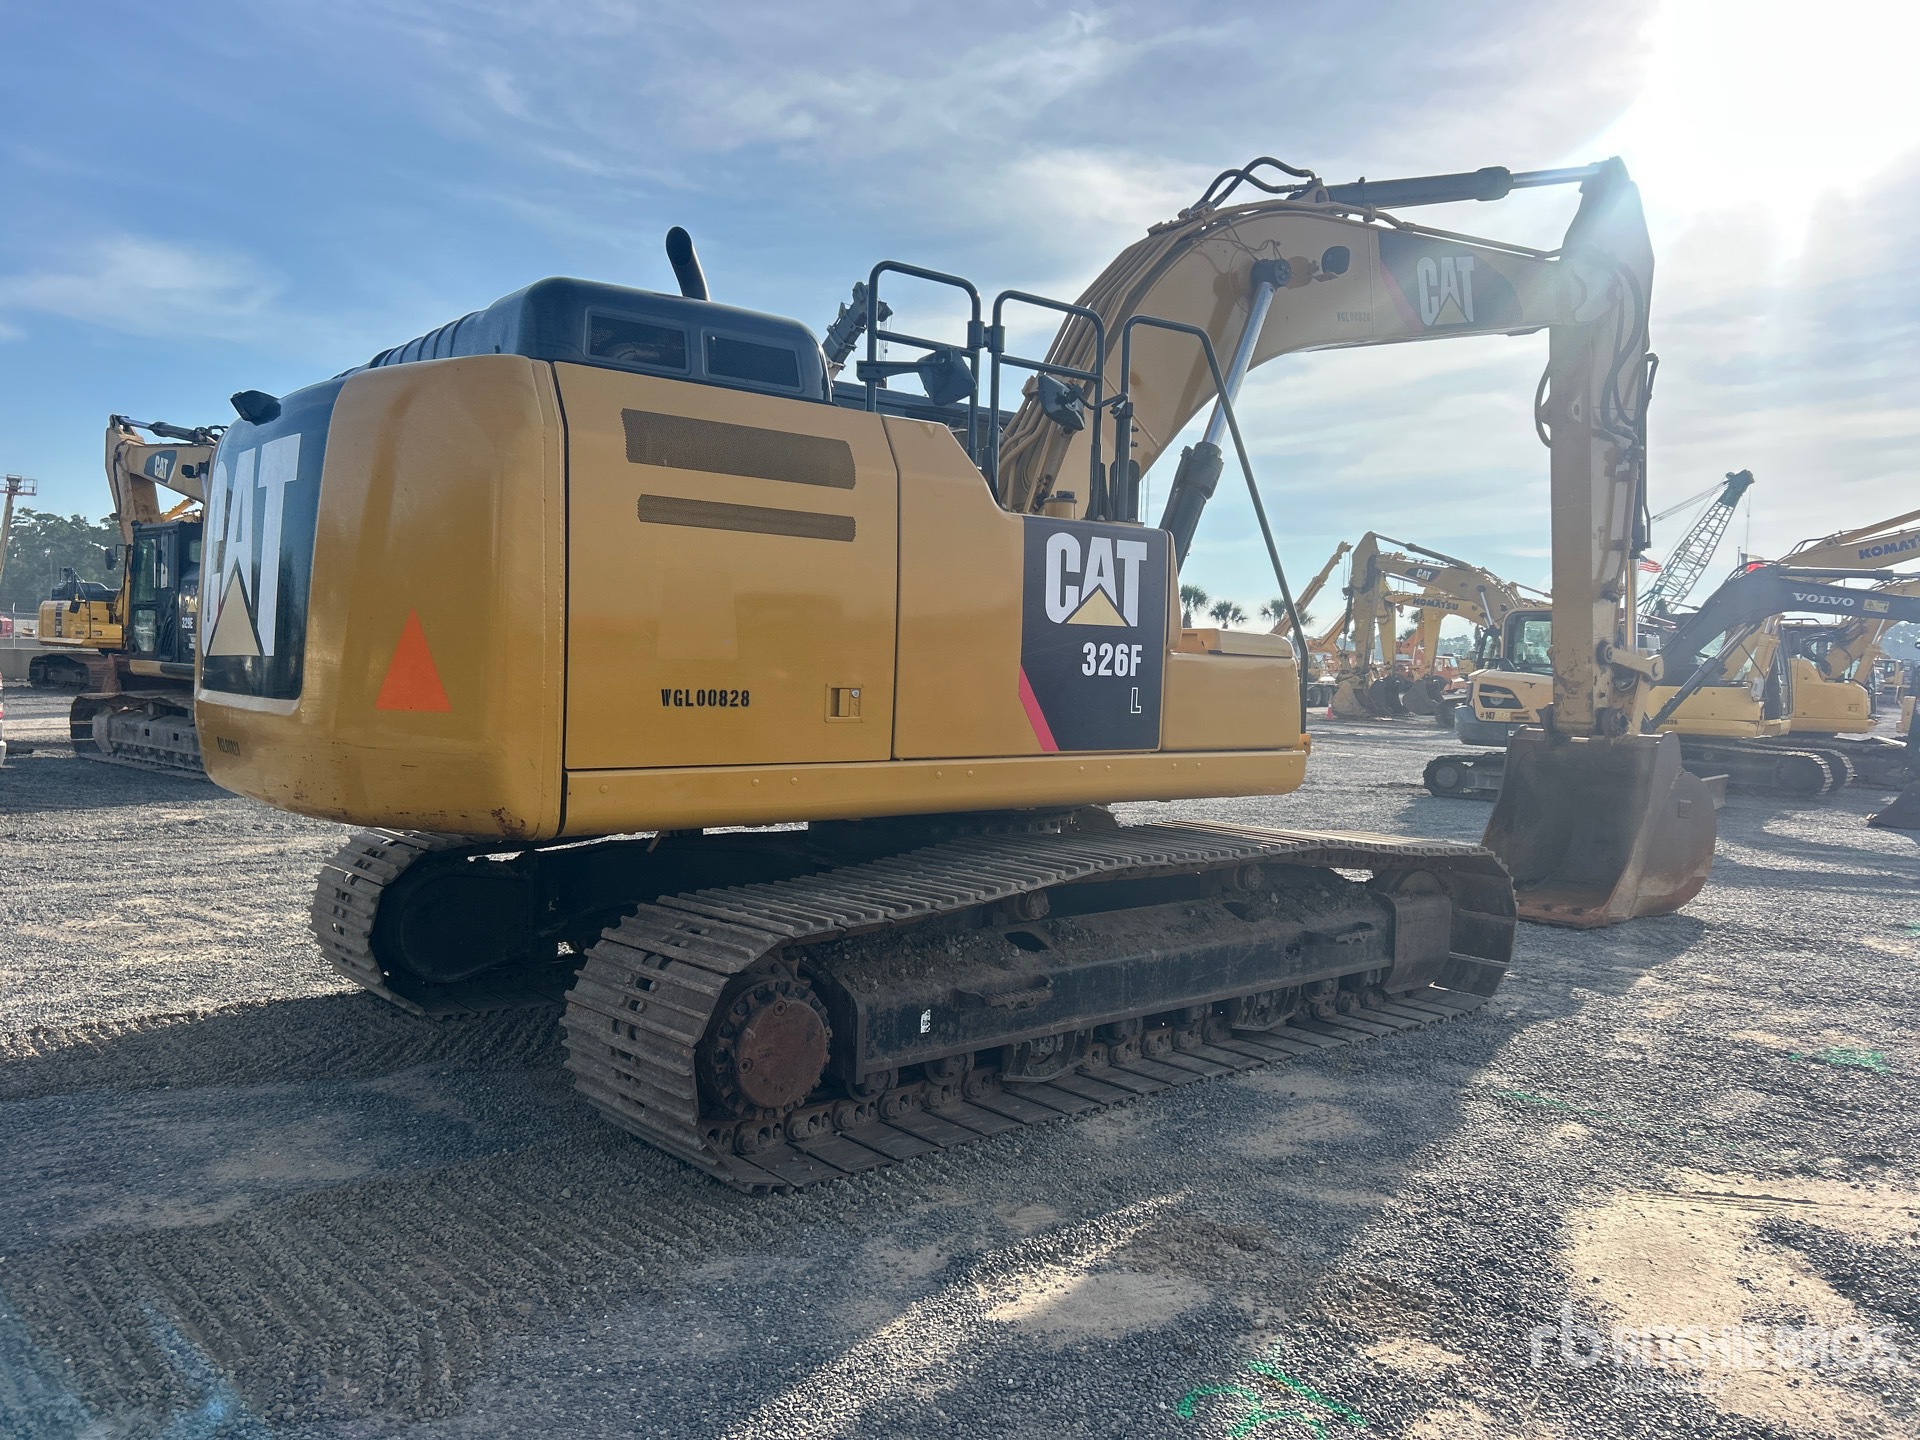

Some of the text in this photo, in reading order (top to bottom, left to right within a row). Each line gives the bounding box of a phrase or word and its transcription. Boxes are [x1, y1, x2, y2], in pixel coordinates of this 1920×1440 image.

[1416, 257, 1475, 327] CAT
[154, 455, 169, 480] CAT
[202, 432, 302, 657] CAT
[1858, 534, 1920, 560] KOMAT
[1045, 532, 1148, 627] CAT
[1416, 568, 1432, 581] CAT
[1412, 597, 1460, 611] KOMATSU
[1792, 592, 1855, 607] VOLVO
[1081, 642, 1143, 677] 326F
[660, 688, 750, 708] WGL00828
[1130, 687, 1142, 714] L
